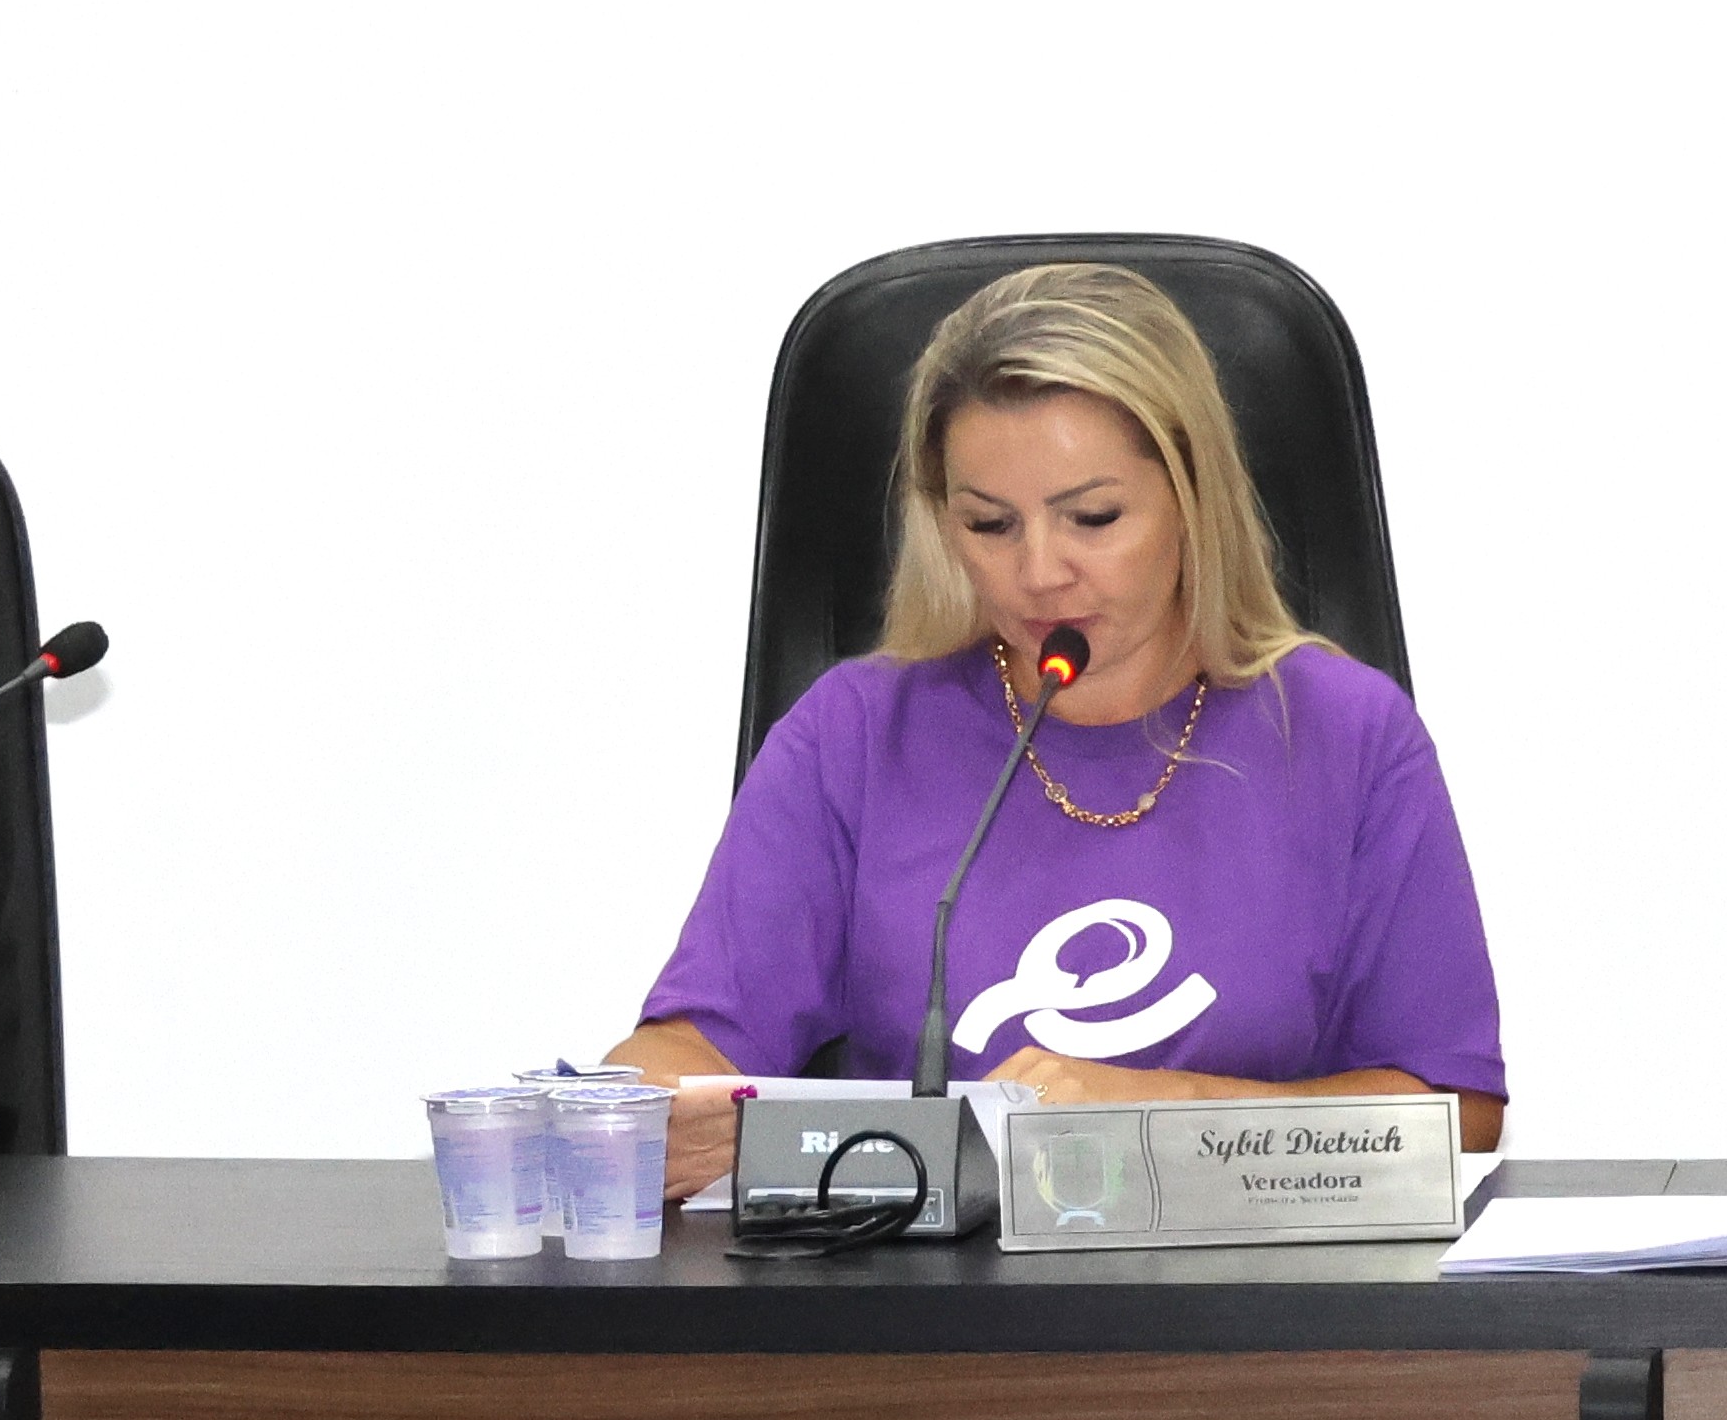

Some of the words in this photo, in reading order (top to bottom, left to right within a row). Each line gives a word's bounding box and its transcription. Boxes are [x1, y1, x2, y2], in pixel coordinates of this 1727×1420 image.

[1197, 1128, 1277, 1166] Sybil
[1285, 1125, 1405, 1156] Dietrich
[1241, 1172, 1362, 1191] Vereadora
